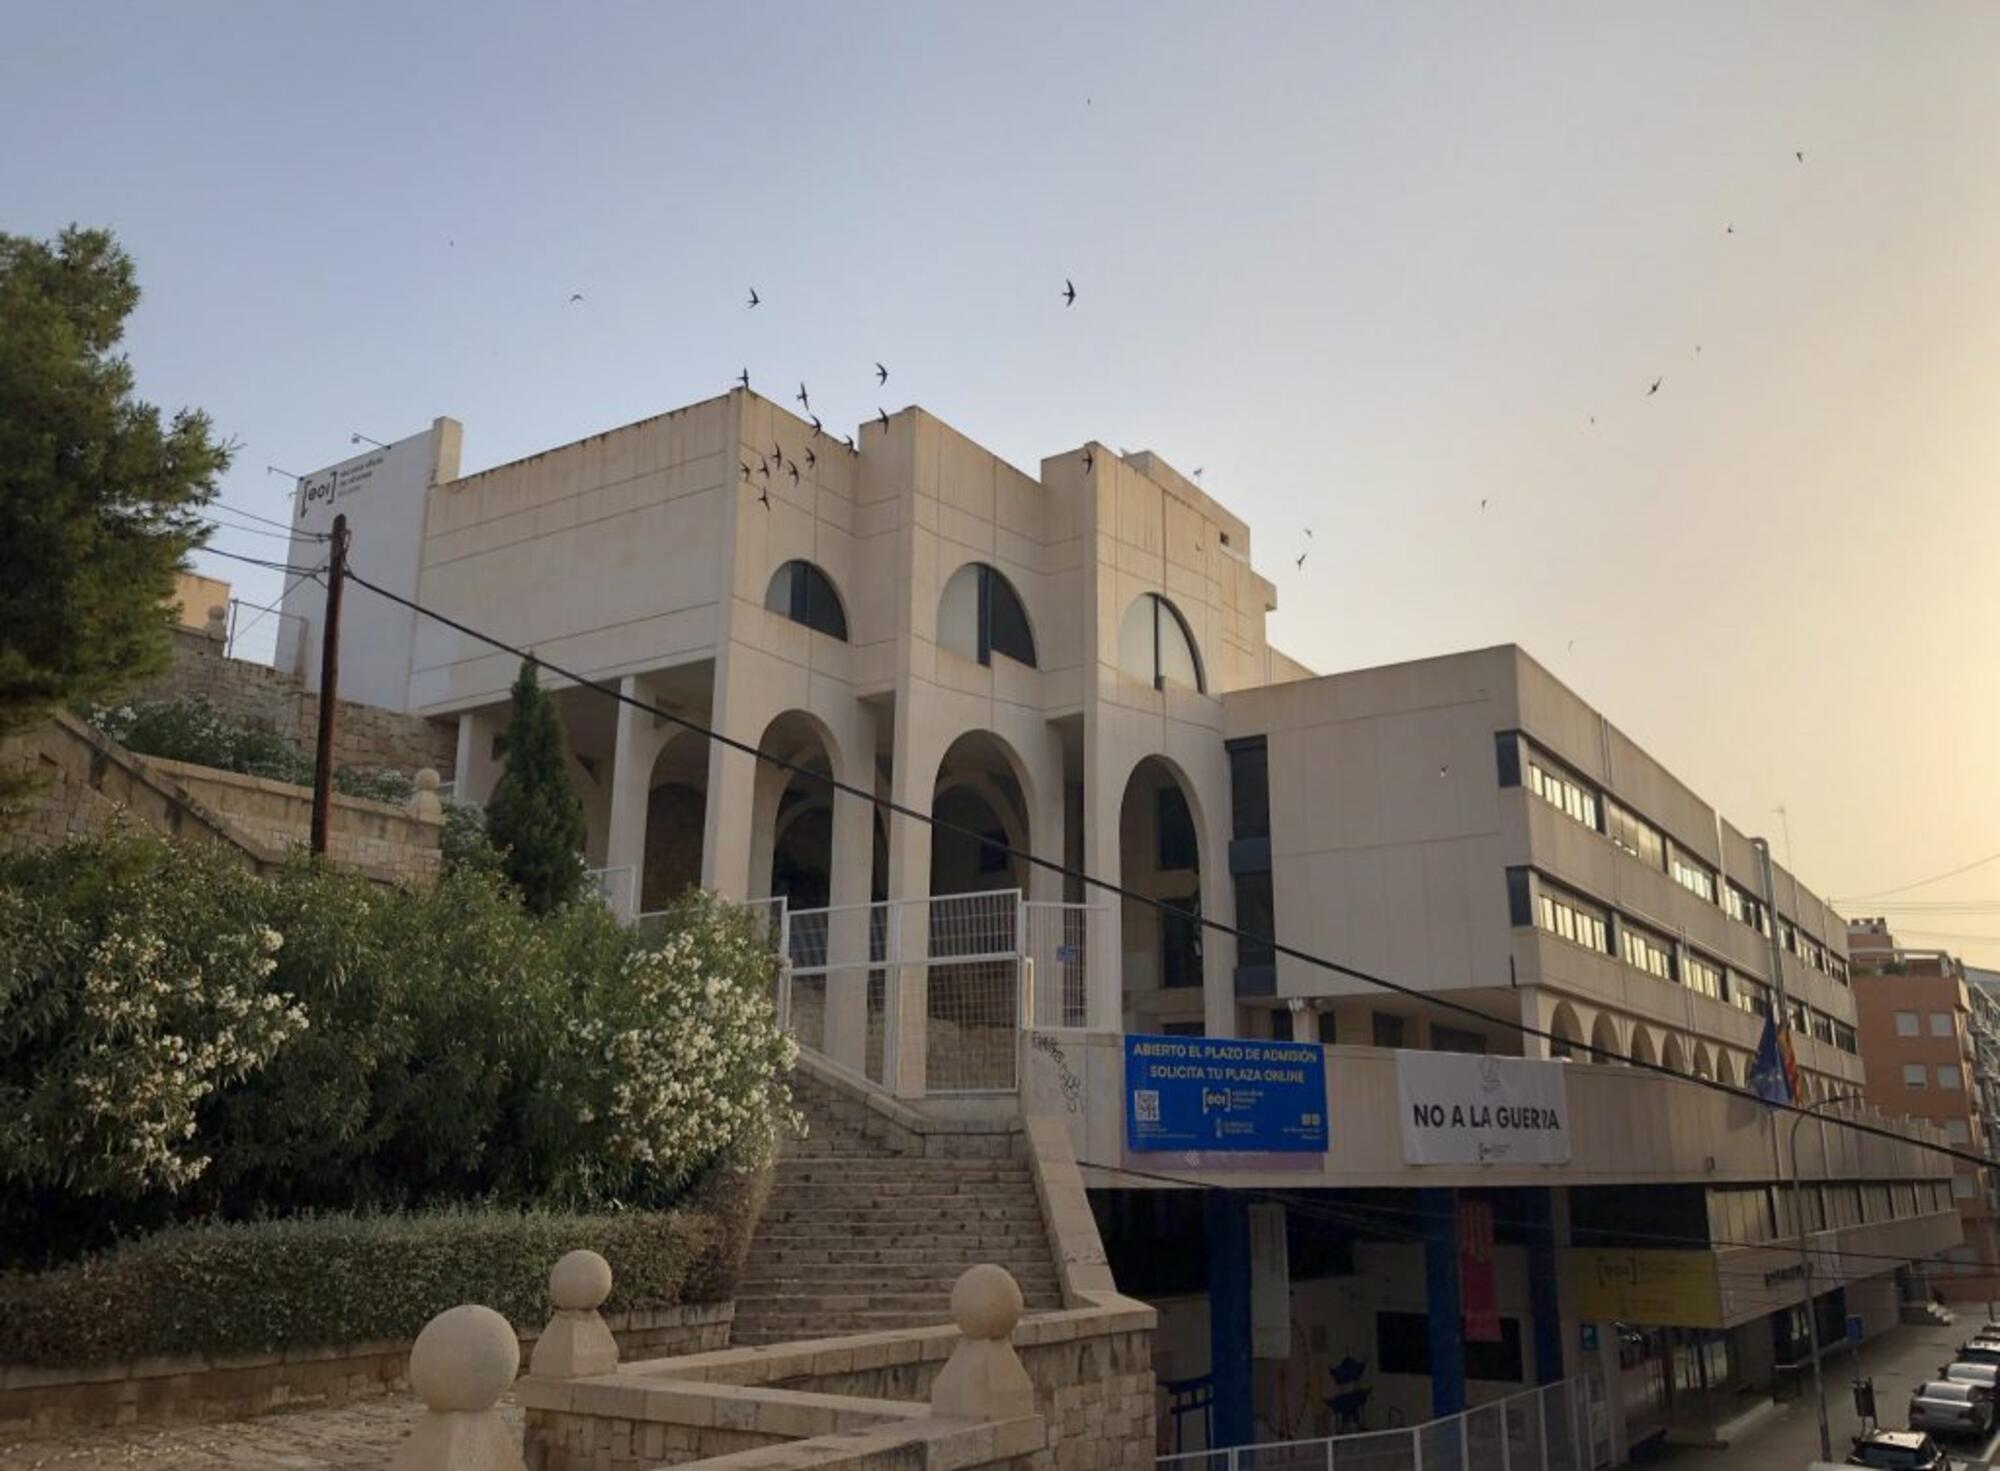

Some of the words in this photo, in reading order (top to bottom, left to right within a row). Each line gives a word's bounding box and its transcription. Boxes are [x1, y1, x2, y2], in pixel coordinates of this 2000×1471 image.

[1134, 1043, 1186, 1057] ABIERTO
[1189, 1045, 1203, 1058] EL
[1206, 1046, 1242, 1060] PLAZO
[1246, 1047, 1260, 1060] DE
[1263, 1046, 1317, 1063] ADMISIÓN
[1150, 1065, 1205, 1079] SOLICITA
[1207, 1067, 1223, 1080] TU
[1226, 1068, 1260, 1081] PLAZA
[1263, 1070, 1304, 1083] ONLINE
[1413, 1104, 1444, 1128] NO
[1451, 1105, 1466, 1128] A
[1470, 1105, 1492, 1128] LA
